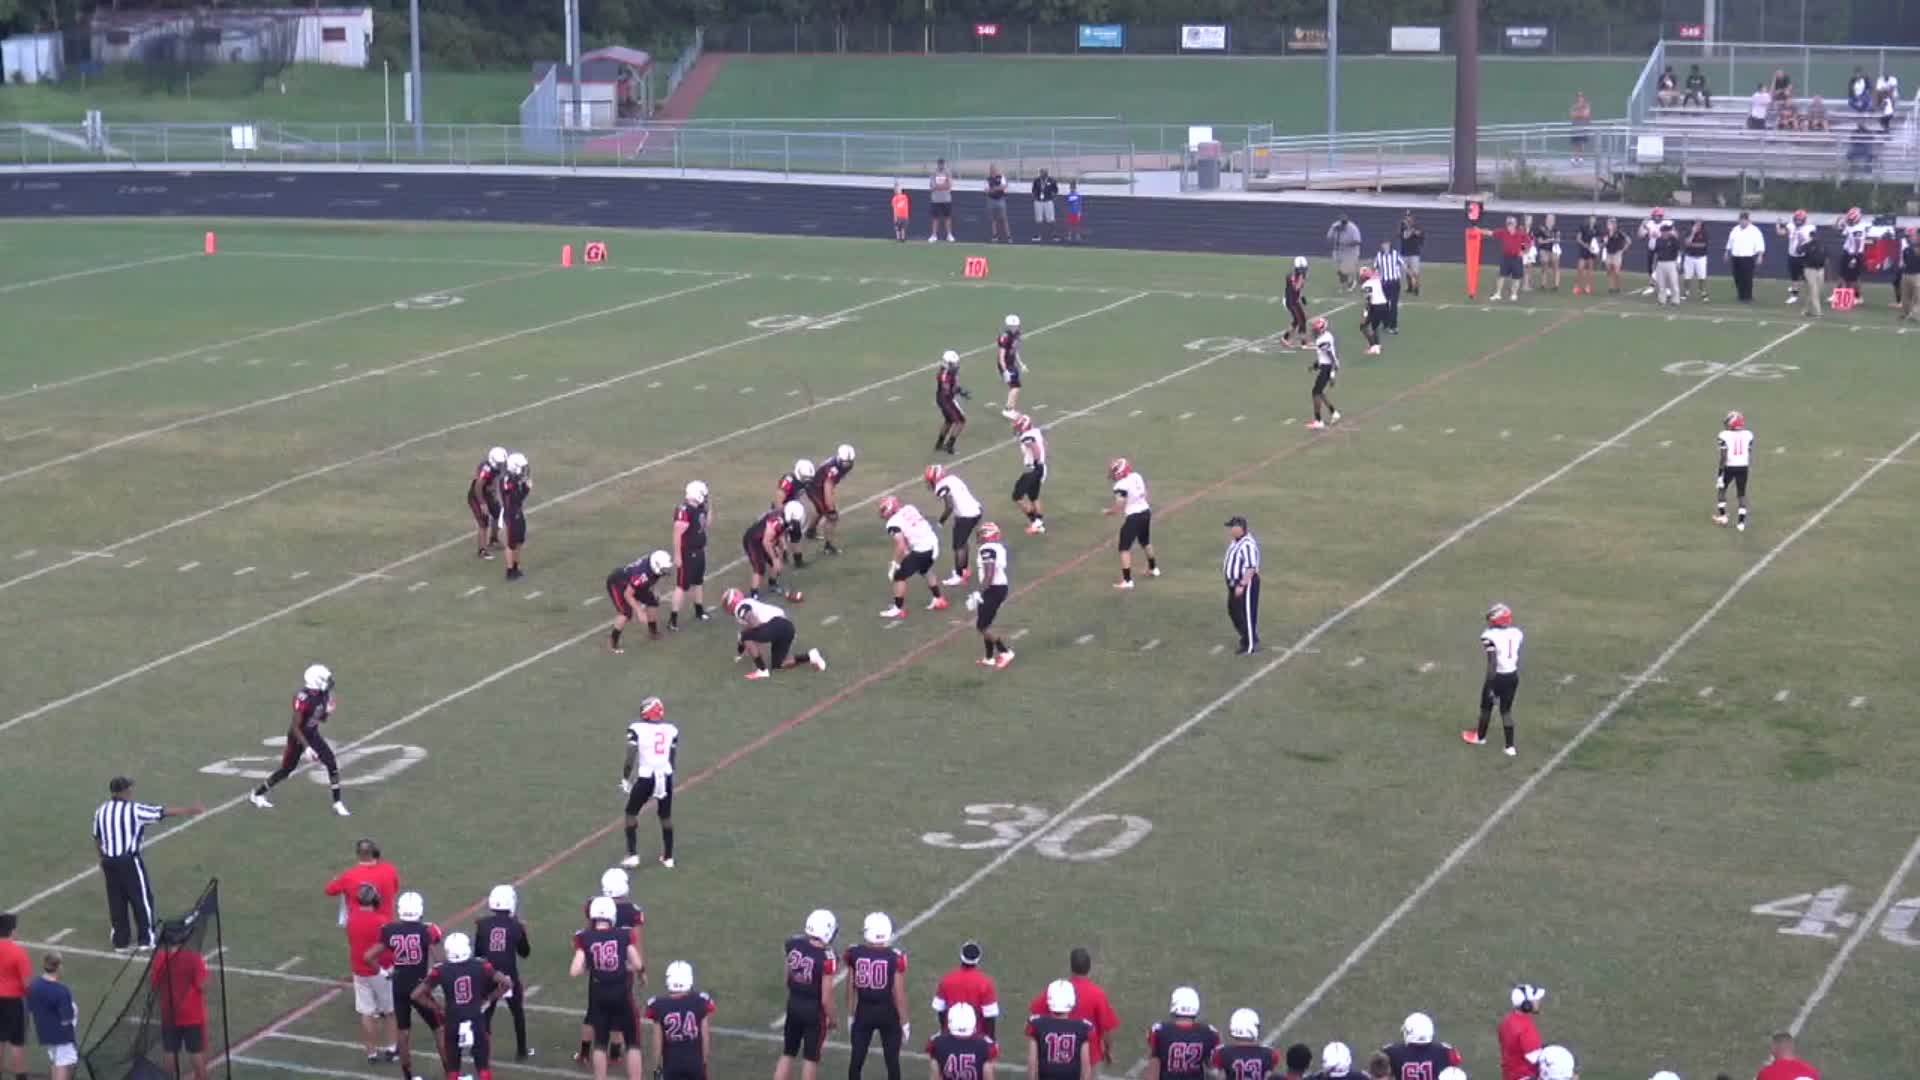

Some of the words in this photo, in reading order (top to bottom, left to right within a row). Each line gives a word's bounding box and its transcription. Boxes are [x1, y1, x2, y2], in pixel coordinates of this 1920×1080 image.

[654, 732, 665, 755] 2
[922, 803, 1153, 859] 30
[390, 934, 422, 965] 26
[591, 940, 618, 971] 18
[855, 958, 888, 989] 80
[454, 976, 472, 1004] 9
[664, 1011, 698, 1041] 24
[1045, 1032, 1075, 1063] 19
